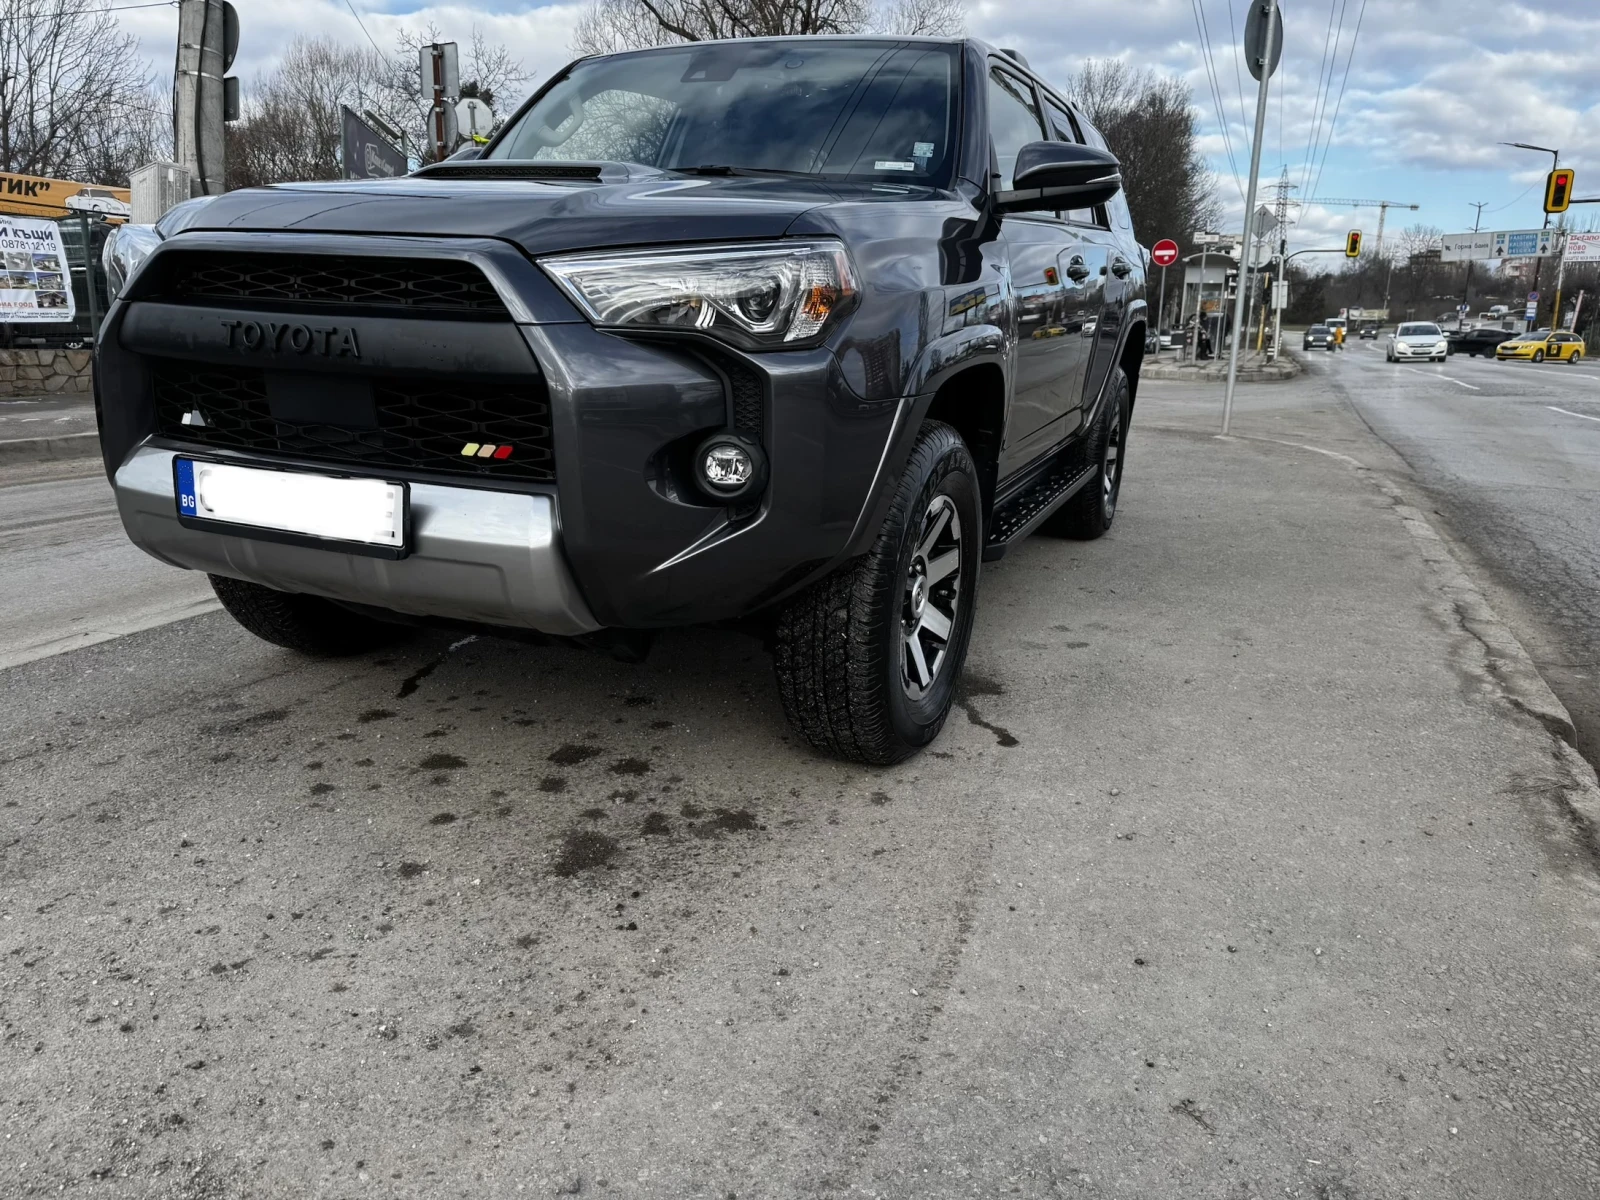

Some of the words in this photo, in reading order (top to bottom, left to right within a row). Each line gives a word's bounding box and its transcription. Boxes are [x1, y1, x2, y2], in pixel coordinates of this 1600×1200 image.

[1, 239, 57, 252] 0878112119
[1454, 243, 1472, 251] Горна
[221, 320, 362, 359] TOYOTA
[181, 494, 195, 508] BG
